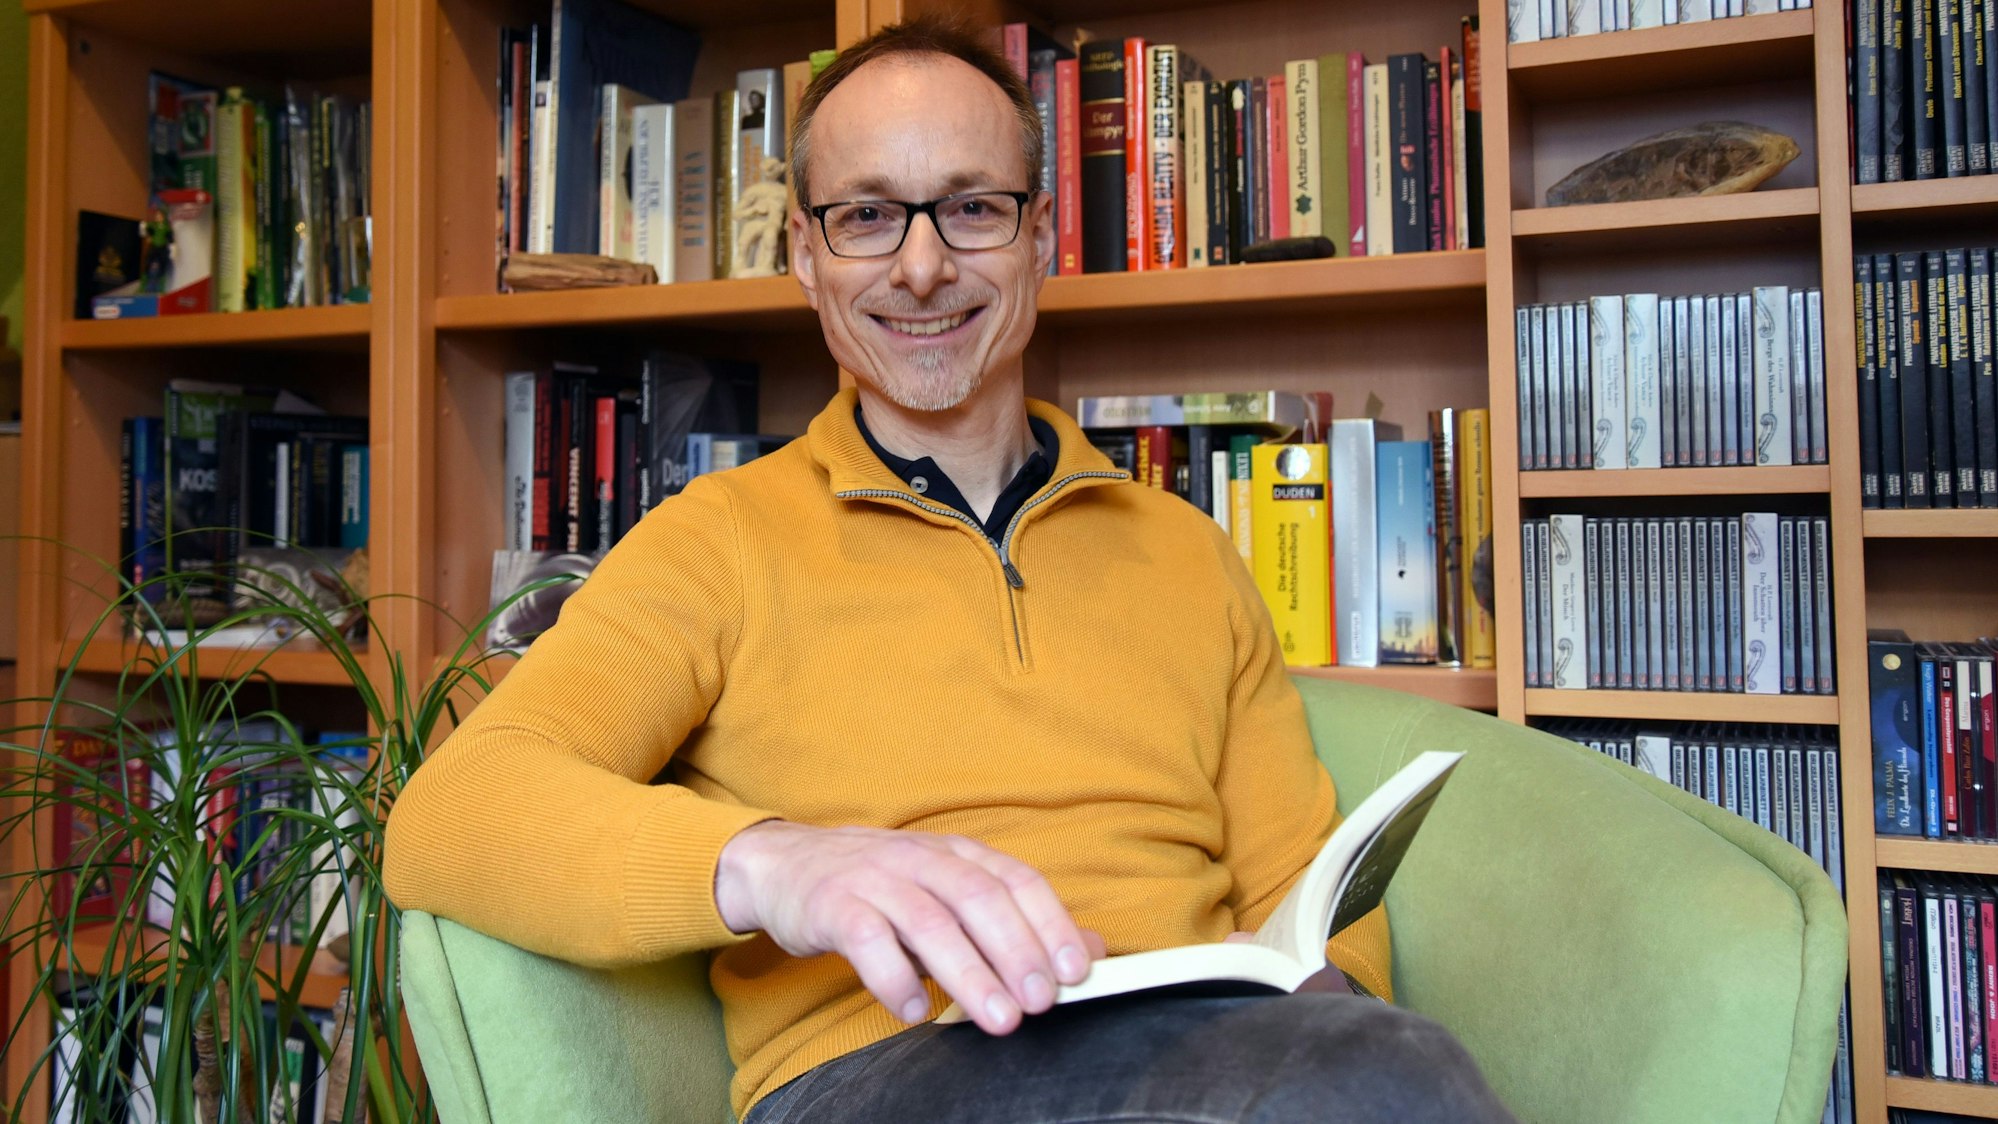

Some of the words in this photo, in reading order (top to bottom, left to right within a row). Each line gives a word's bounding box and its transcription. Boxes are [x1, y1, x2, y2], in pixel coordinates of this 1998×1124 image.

[1951, 22, 1960, 56] Stevenson
[1974, 12, 1983, 39] Dickens
[1952, 57, 1961, 75] Louis
[1975, 40, 1984, 66] Charles
[1153, 47, 1173, 109] EXORZIST
[1294, 63, 1310, 95] Pym
[1953, 75, 1962, 98] Robert
[1153, 113, 1173, 138] DER
[1294, 97, 1309, 145] Gordon
[1153, 152, 1174, 201] BLATTY
[1295, 148, 1310, 192] Arthur
[1855, 282, 1864, 316] LITERATUR
[1876, 282, 1885, 316] LITERATUR
[1901, 280, 1911, 314] LITERATUR
[1928, 277, 1937, 313] LITERATUR
[1936, 277, 1945, 293] Welt
[1937, 293, 1945, 305] der
[1947, 274, 1958, 309] LITERATUR
[1971, 275, 1981, 310] LITERATUR
[1937, 305, 1946, 324] Feind
[1958, 304, 1967, 336] Hoffmann
[1982, 306, 1990, 318] und
[1857, 319, 1867, 368] PHANTASTISCHE
[1878, 318, 1887, 368] PHANTASTISCHE
[1903, 316, 1913, 367] PHANTASTISCHE
[1929, 314, 1939, 365] PHANTASTISCHE
[1938, 325, 1946, 336] Der
[1950, 310, 1961, 361] PHANTASTISCHE
[1973, 310, 1983, 362] PHANTASTISCHE
[1766, 338, 1775, 358] Berge
[1939, 343, 1948, 368] London
[1984, 363, 1992, 375] Poe
[1767, 374, 1775, 413] Wahnsinns
[567, 447, 581, 517] VINCENT
[1273, 486, 1316, 500] DUDEN
[1308, 505, 1315, 518] 1
[1276, 522, 1287, 571] deutsche
[1287, 522, 1299, 612] Rechtschreibung
[1277, 575, 1287, 592] Die
[1759, 586, 1767, 616] Schatten
[1760, 617, 1768, 633] über
[1925, 664, 1933, 680] Hugh
[1925, 681, 1934, 703] Walker
[1885, 760, 1895, 787] PALMA
[1886, 798, 1896, 818] FÉLIX
[1899, 815, 1910, 827] Die
